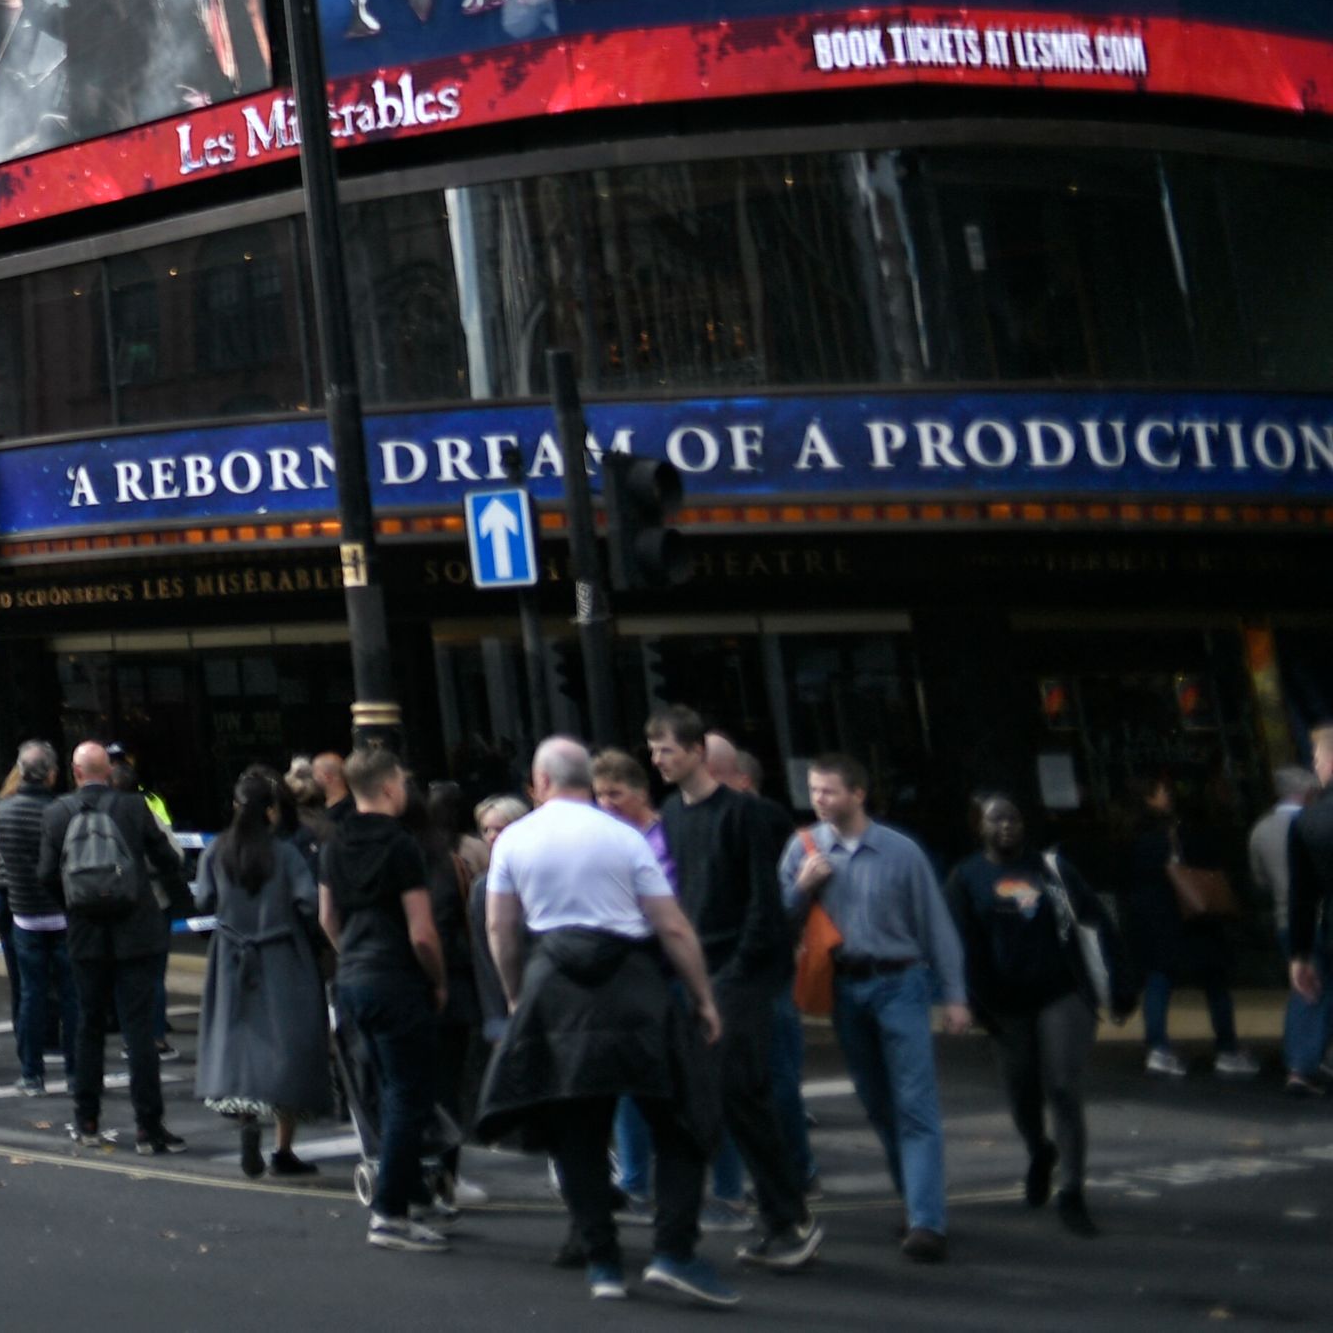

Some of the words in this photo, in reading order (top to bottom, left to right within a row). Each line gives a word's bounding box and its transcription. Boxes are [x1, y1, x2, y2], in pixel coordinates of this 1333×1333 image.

[813, 28, 887, 70] BOOK
[985, 28, 1013, 68] AT
[1013, 29, 1147, 76] LESMIS.COM
[176, 122, 237, 174] Les
[114, 445, 338, 504] REBORN
[666, 422, 765, 473] OF
[793, 418, 843, 469] A
[142, 577, 186, 601] LES
